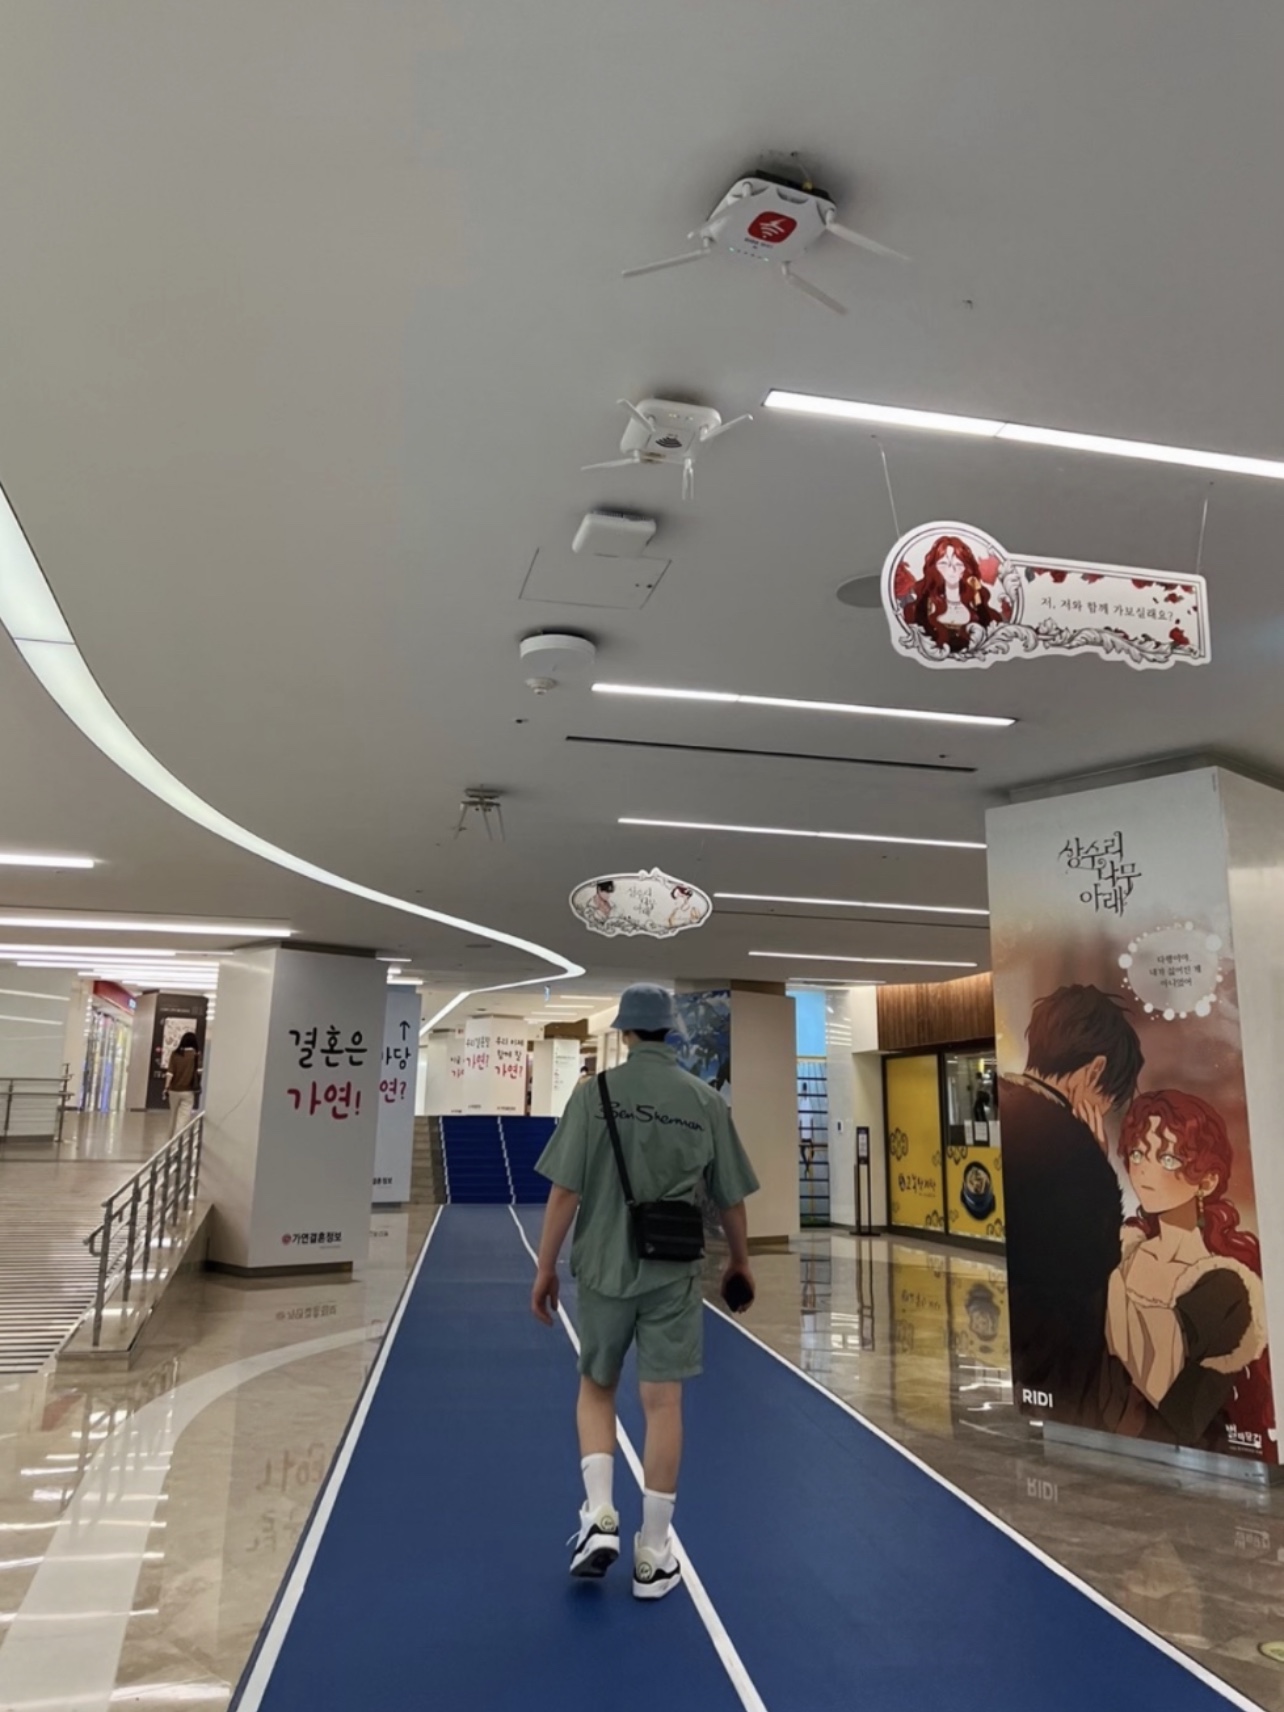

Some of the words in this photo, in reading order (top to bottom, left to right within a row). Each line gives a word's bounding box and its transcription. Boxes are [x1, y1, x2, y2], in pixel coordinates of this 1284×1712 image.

[1060, 598, 1082, 612] 저와
[1087, 601, 1109, 615] 함께
[1113, 604, 1174, 621] 가보실래요?
[1057, 830, 1125, 870] 상수리
[1097, 858, 1143, 896] 나무
[1079, 882, 1129, 917] 아래
[288, 1024, 368, 1069] 결혼은
[381, 1046, 412, 1070] 당
[287, 1080, 362, 1120] 가연!
[379, 1078, 407, 1103] 연?
[636, 1103, 705, 1132] Sherman
[292, 1231, 342, 1245] 가연결혼정보
[1022, 1388, 1054, 1408] RIDI
